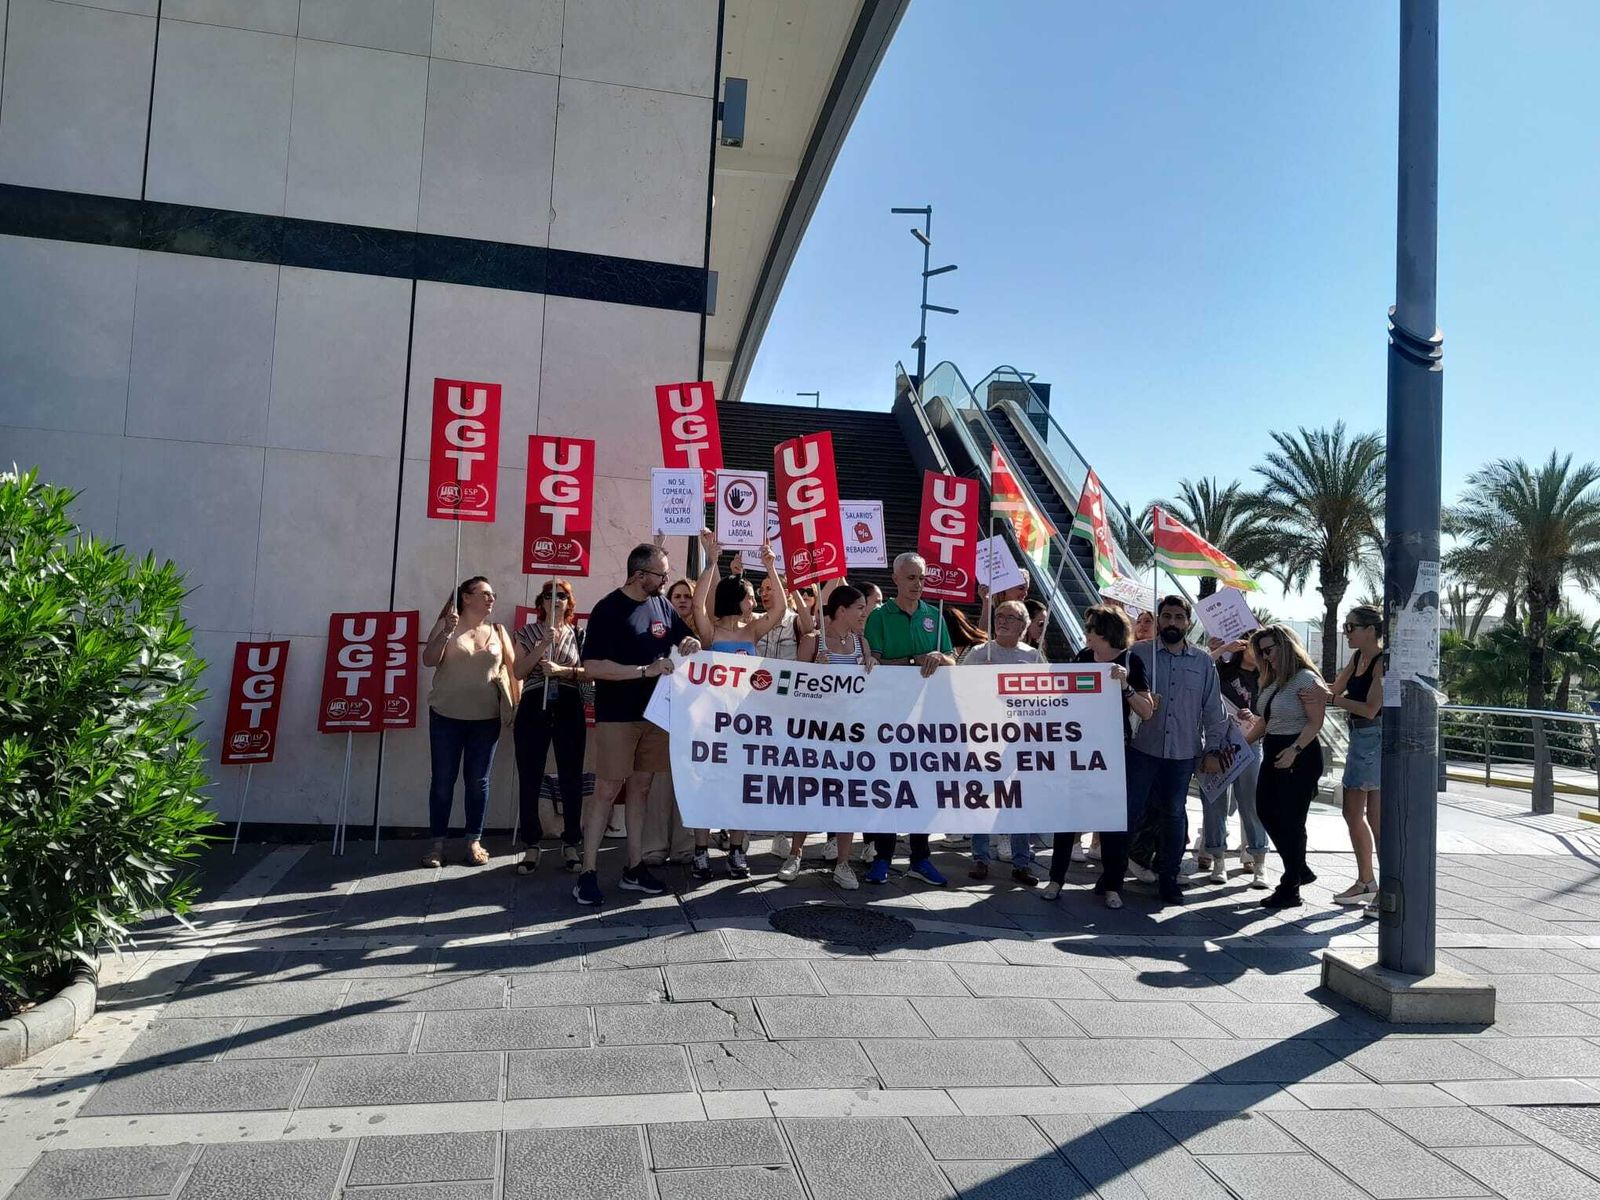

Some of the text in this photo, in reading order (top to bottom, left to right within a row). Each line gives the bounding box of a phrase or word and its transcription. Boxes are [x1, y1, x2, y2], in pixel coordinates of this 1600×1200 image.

[444, 386, 487, 481] UGT
[669, 387, 709, 468] UGT
[441, 486, 459, 496] UGT
[539, 442, 581, 536] UGT
[783, 441, 827, 544] UGT
[728, 529, 753, 537] LABORAL
[930, 479, 967, 564] UGT
[534, 541, 554, 551] UGT
[846, 546, 878, 554] REBAJADOS
[945, 570, 959, 578] FSP
[336, 618, 377, 696] UGT
[240, 647, 280, 728] UGT
[687, 661, 866, 694] UGT FeSMC
[1004, 675, 1069, 691] CCOO
[330, 701, 347, 710] UGT
[793, 690, 823, 699] Granada
[1006, 696, 1069, 708] servicios
[1006, 708, 1047, 718] granada
[233, 734, 250, 743] UGT
[714, 711, 1083, 744] POR UNAS CONDICIONES
[691, 740, 1108, 773] DE TRABAJO DIGNAS EN LA
[742, 773, 1023, 810] EMPRESA H&M
